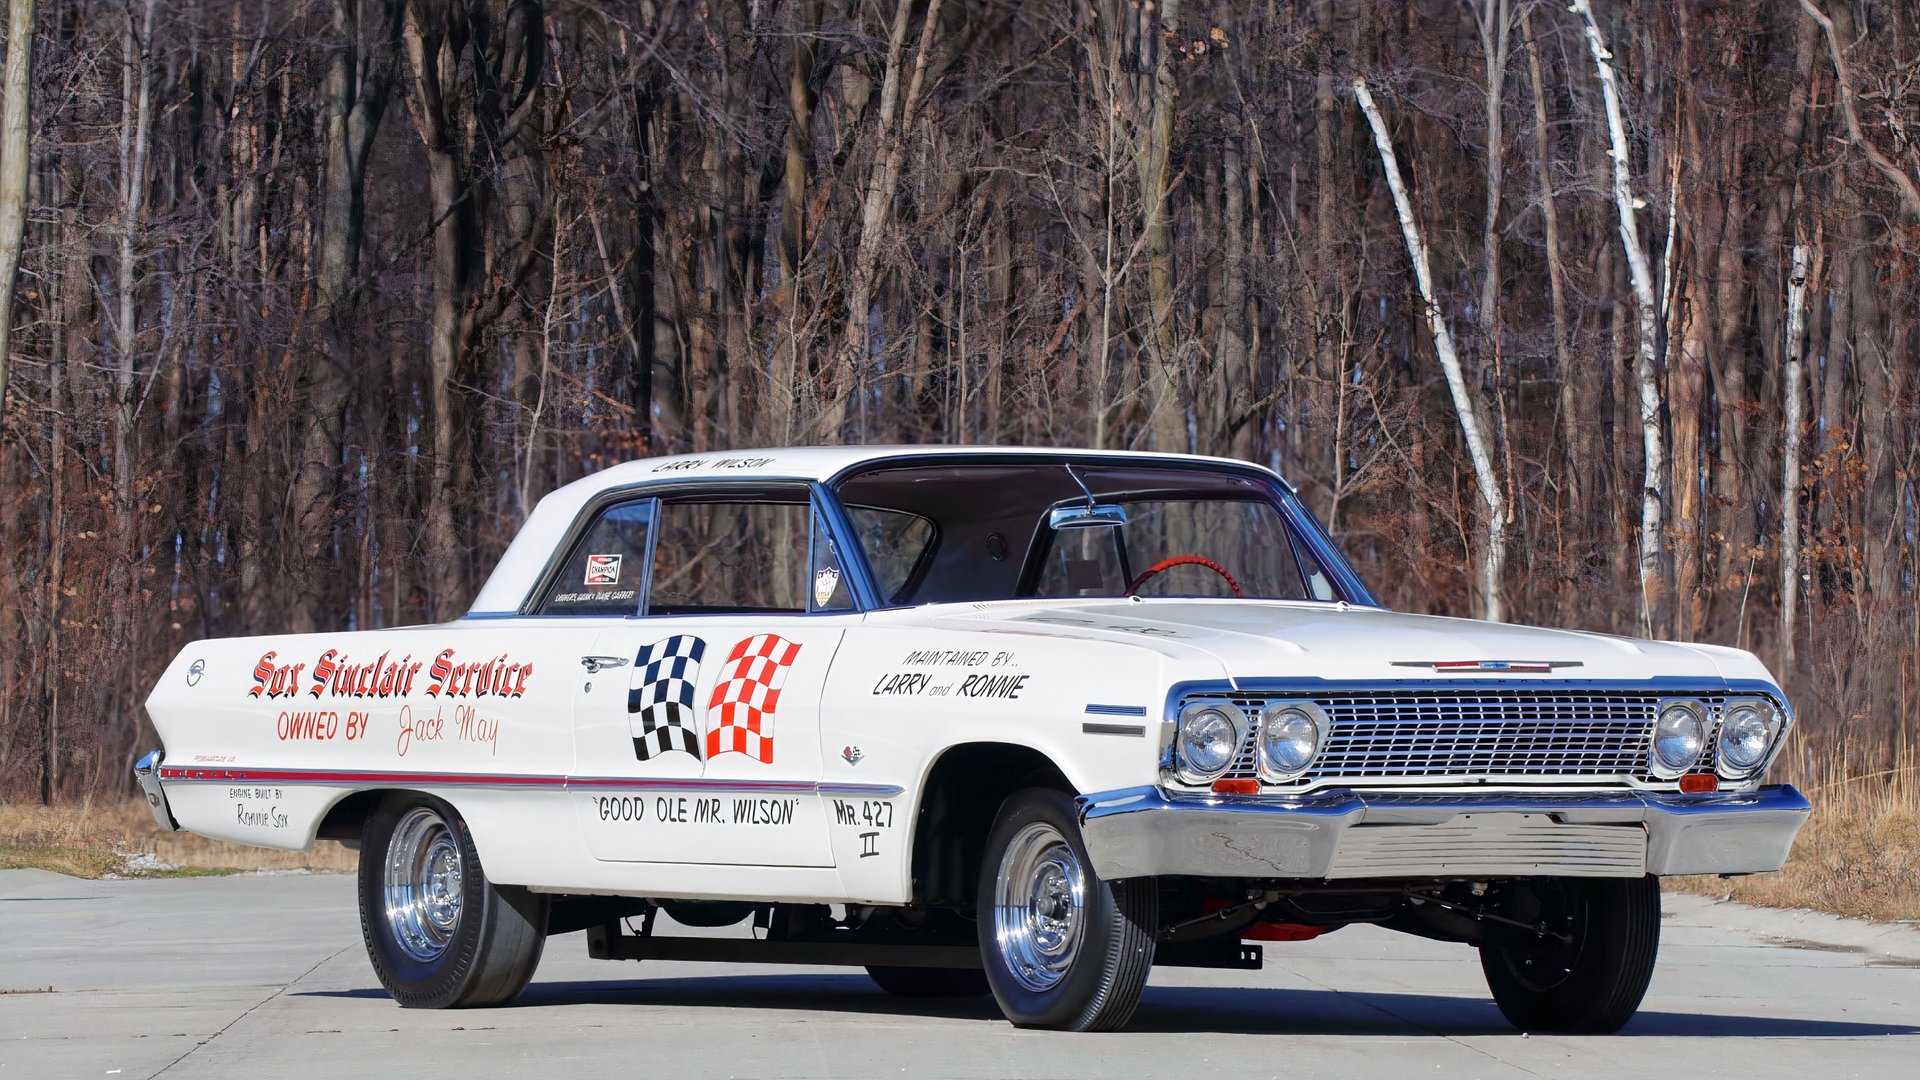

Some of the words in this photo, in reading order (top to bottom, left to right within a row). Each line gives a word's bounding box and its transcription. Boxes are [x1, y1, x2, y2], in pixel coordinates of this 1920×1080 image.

[651, 458, 711, 473] LARRY
[711, 457, 777, 469] WILSON
[902, 650, 989, 667] MAINTAINED
[246, 650, 306, 700] Sox
[308, 648, 423, 700] Sinclair
[424, 648, 534, 700] Service
[872, 673, 933, 696] LARRY
[928, 682, 954, 697] and
[956, 674, 1030, 699] RONNIE
[277, 711, 338, 741] OWNED
[346, 711, 369, 741] BY
[397, 704, 444, 757] Jack
[455, 704, 499, 757] May
[229, 788, 252, 799] ENGINE
[254, 788, 271, 800] BUILT
[275, 789, 283, 800] BY
[237, 803, 269, 827] Ronnie
[271, 806, 288, 829] Sox
[656, 796, 688, 823] OLE
[694, 797, 726, 824] MR.
[862, 800, 893, 828] 427
[859, 831, 880, 858] II
